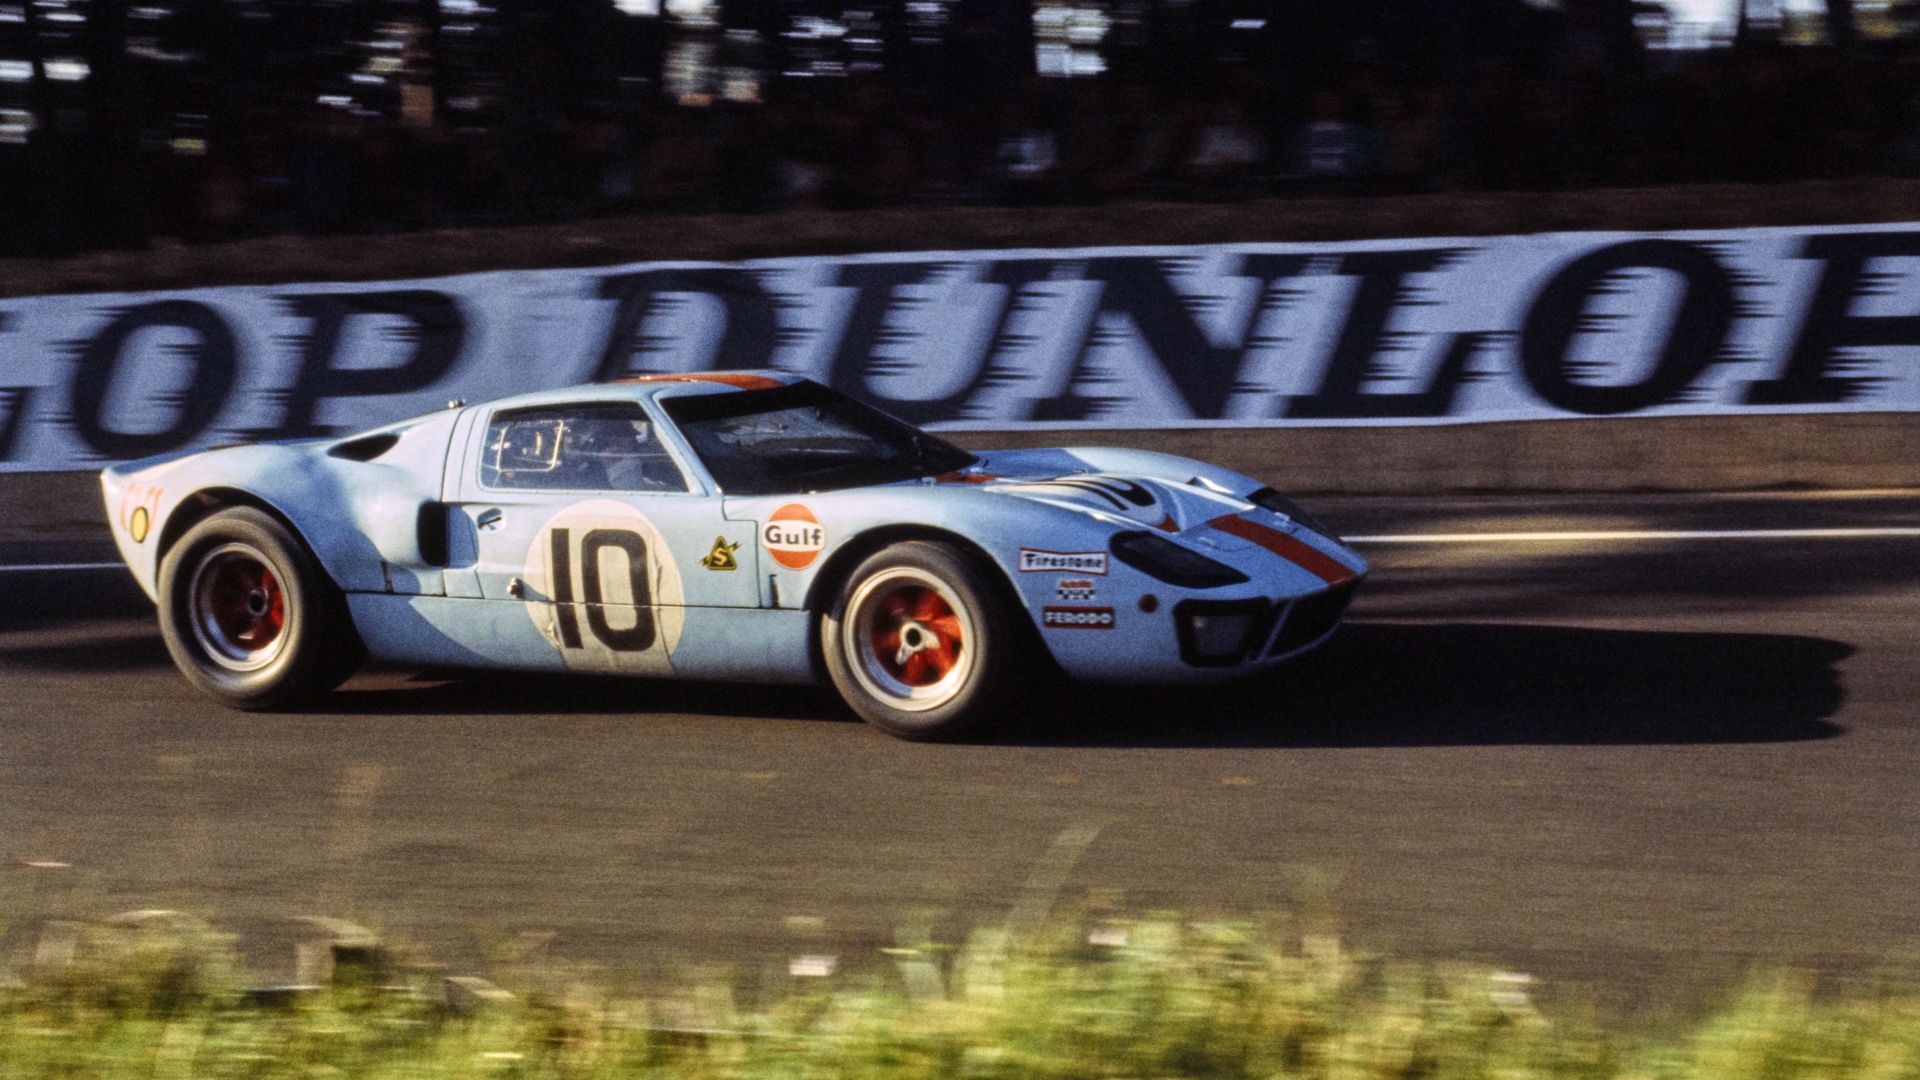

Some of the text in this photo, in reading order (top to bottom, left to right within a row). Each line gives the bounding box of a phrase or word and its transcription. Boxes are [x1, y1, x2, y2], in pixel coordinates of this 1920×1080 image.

[765, 525, 820, 545] Gulf
[713, 548, 727, 565] S
[1024, 553, 1102, 568] Firestone
[551, 528, 656, 652] 10
[1046, 612, 1111, 624] FERODO
